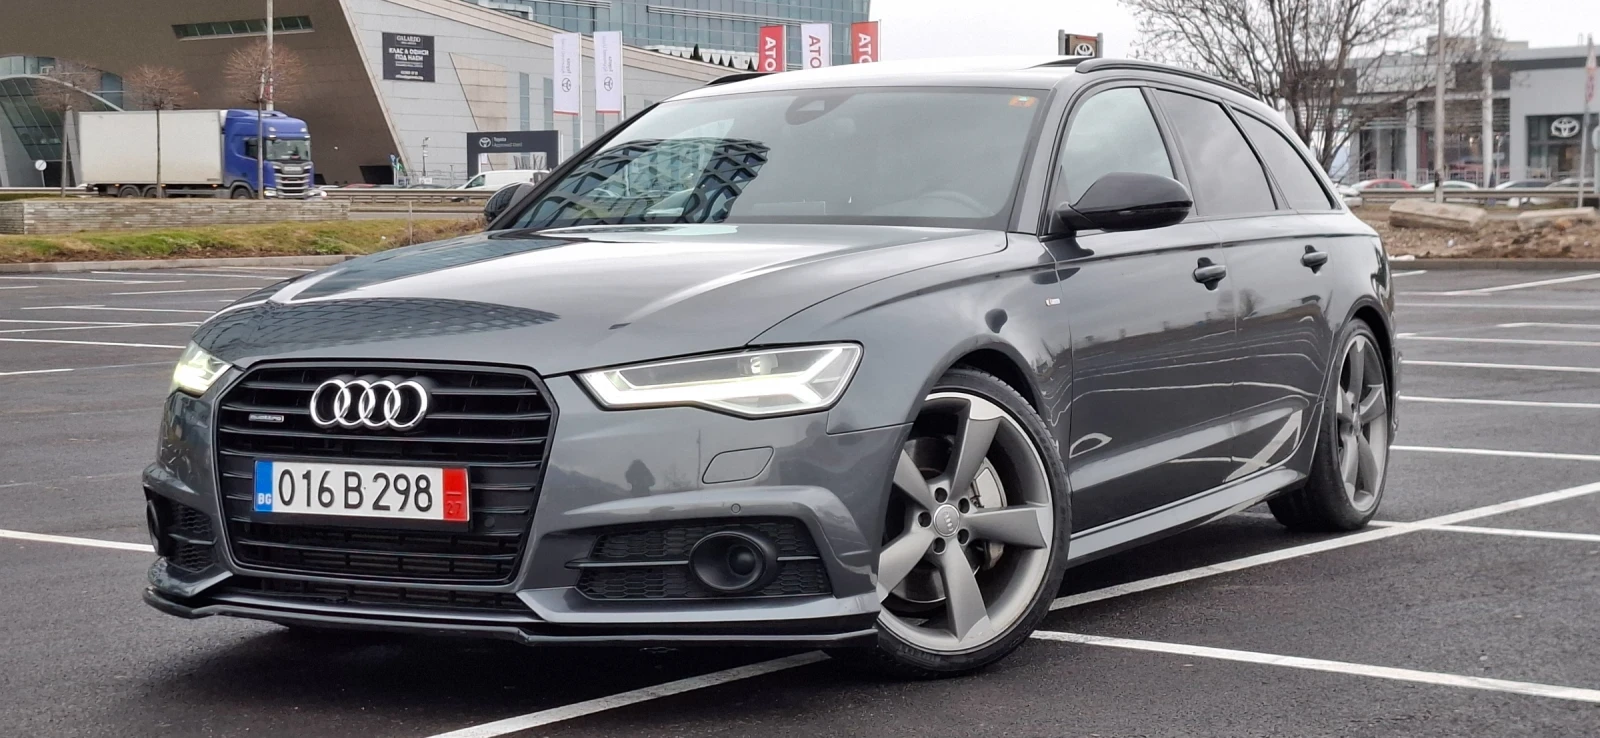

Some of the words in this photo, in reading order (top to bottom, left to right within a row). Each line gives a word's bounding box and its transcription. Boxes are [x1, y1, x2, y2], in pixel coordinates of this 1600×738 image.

[764, 36, 777, 72] ATO
[258, 492, 272, 505] BG
[278, 468, 335, 508] 016
[344, 471, 364, 509] B
[372, 472, 433, 512] 298
[447, 500, 462, 516] 27
